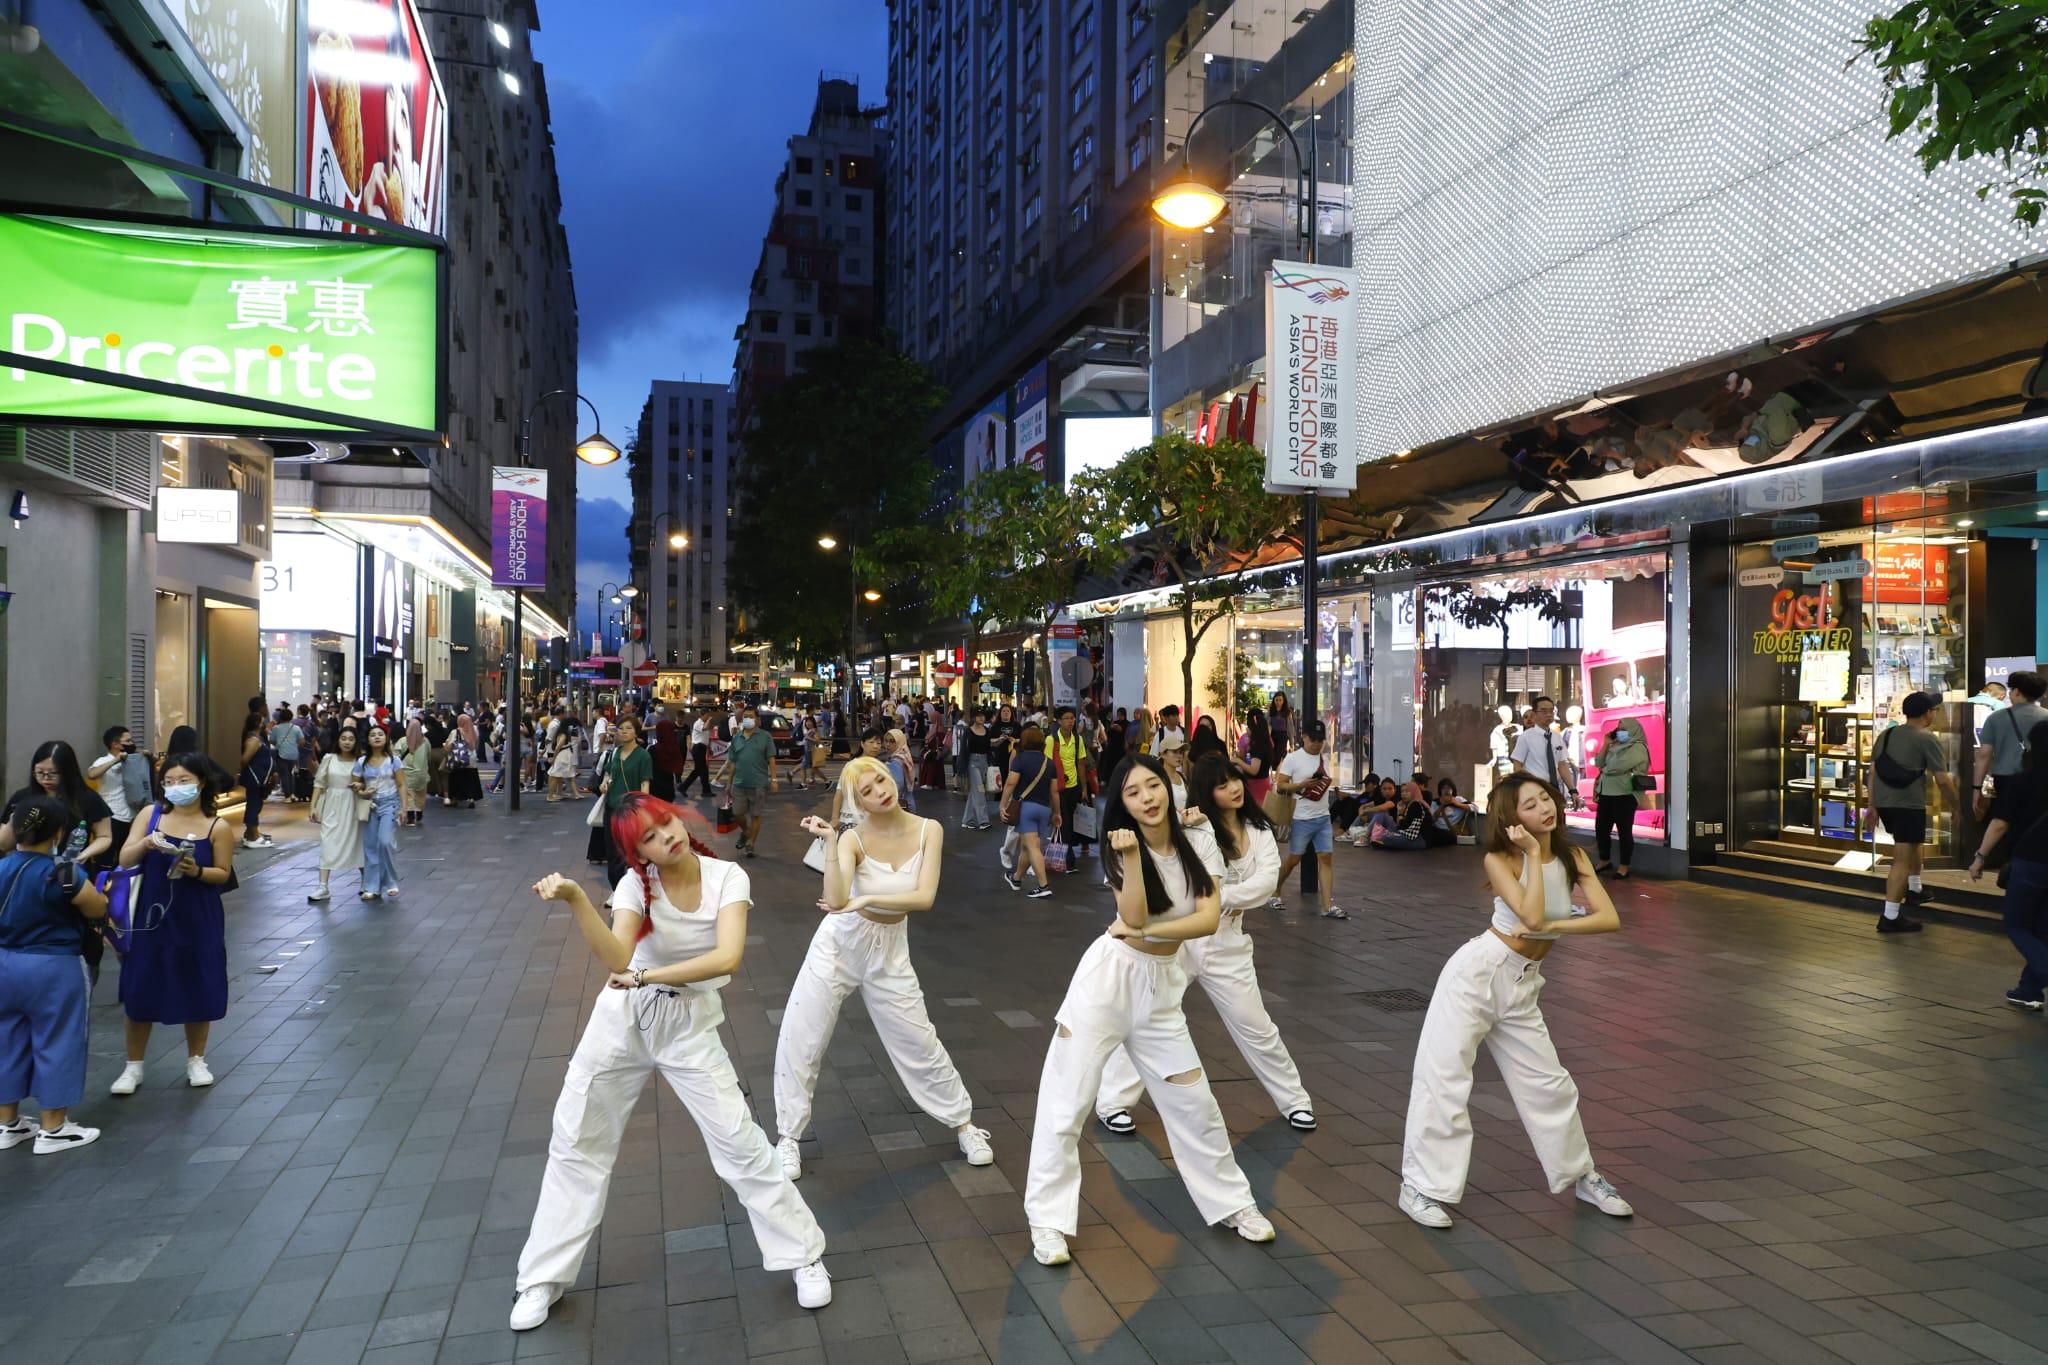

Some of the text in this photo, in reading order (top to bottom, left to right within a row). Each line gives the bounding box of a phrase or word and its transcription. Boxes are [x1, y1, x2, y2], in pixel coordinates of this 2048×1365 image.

[227, 276, 375, 336] 實惠
[11, 313, 376, 400] Pricerite
[1288, 315, 1300, 476] ASIA'S WORLD CITY
[1301, 315, 1318, 478] HONG KONG
[508, 499, 517, 580] ASIA'S WORLD CITY
[516, 499, 527, 581] HONG KONG
[1993, 666, 2008, 676] LG
